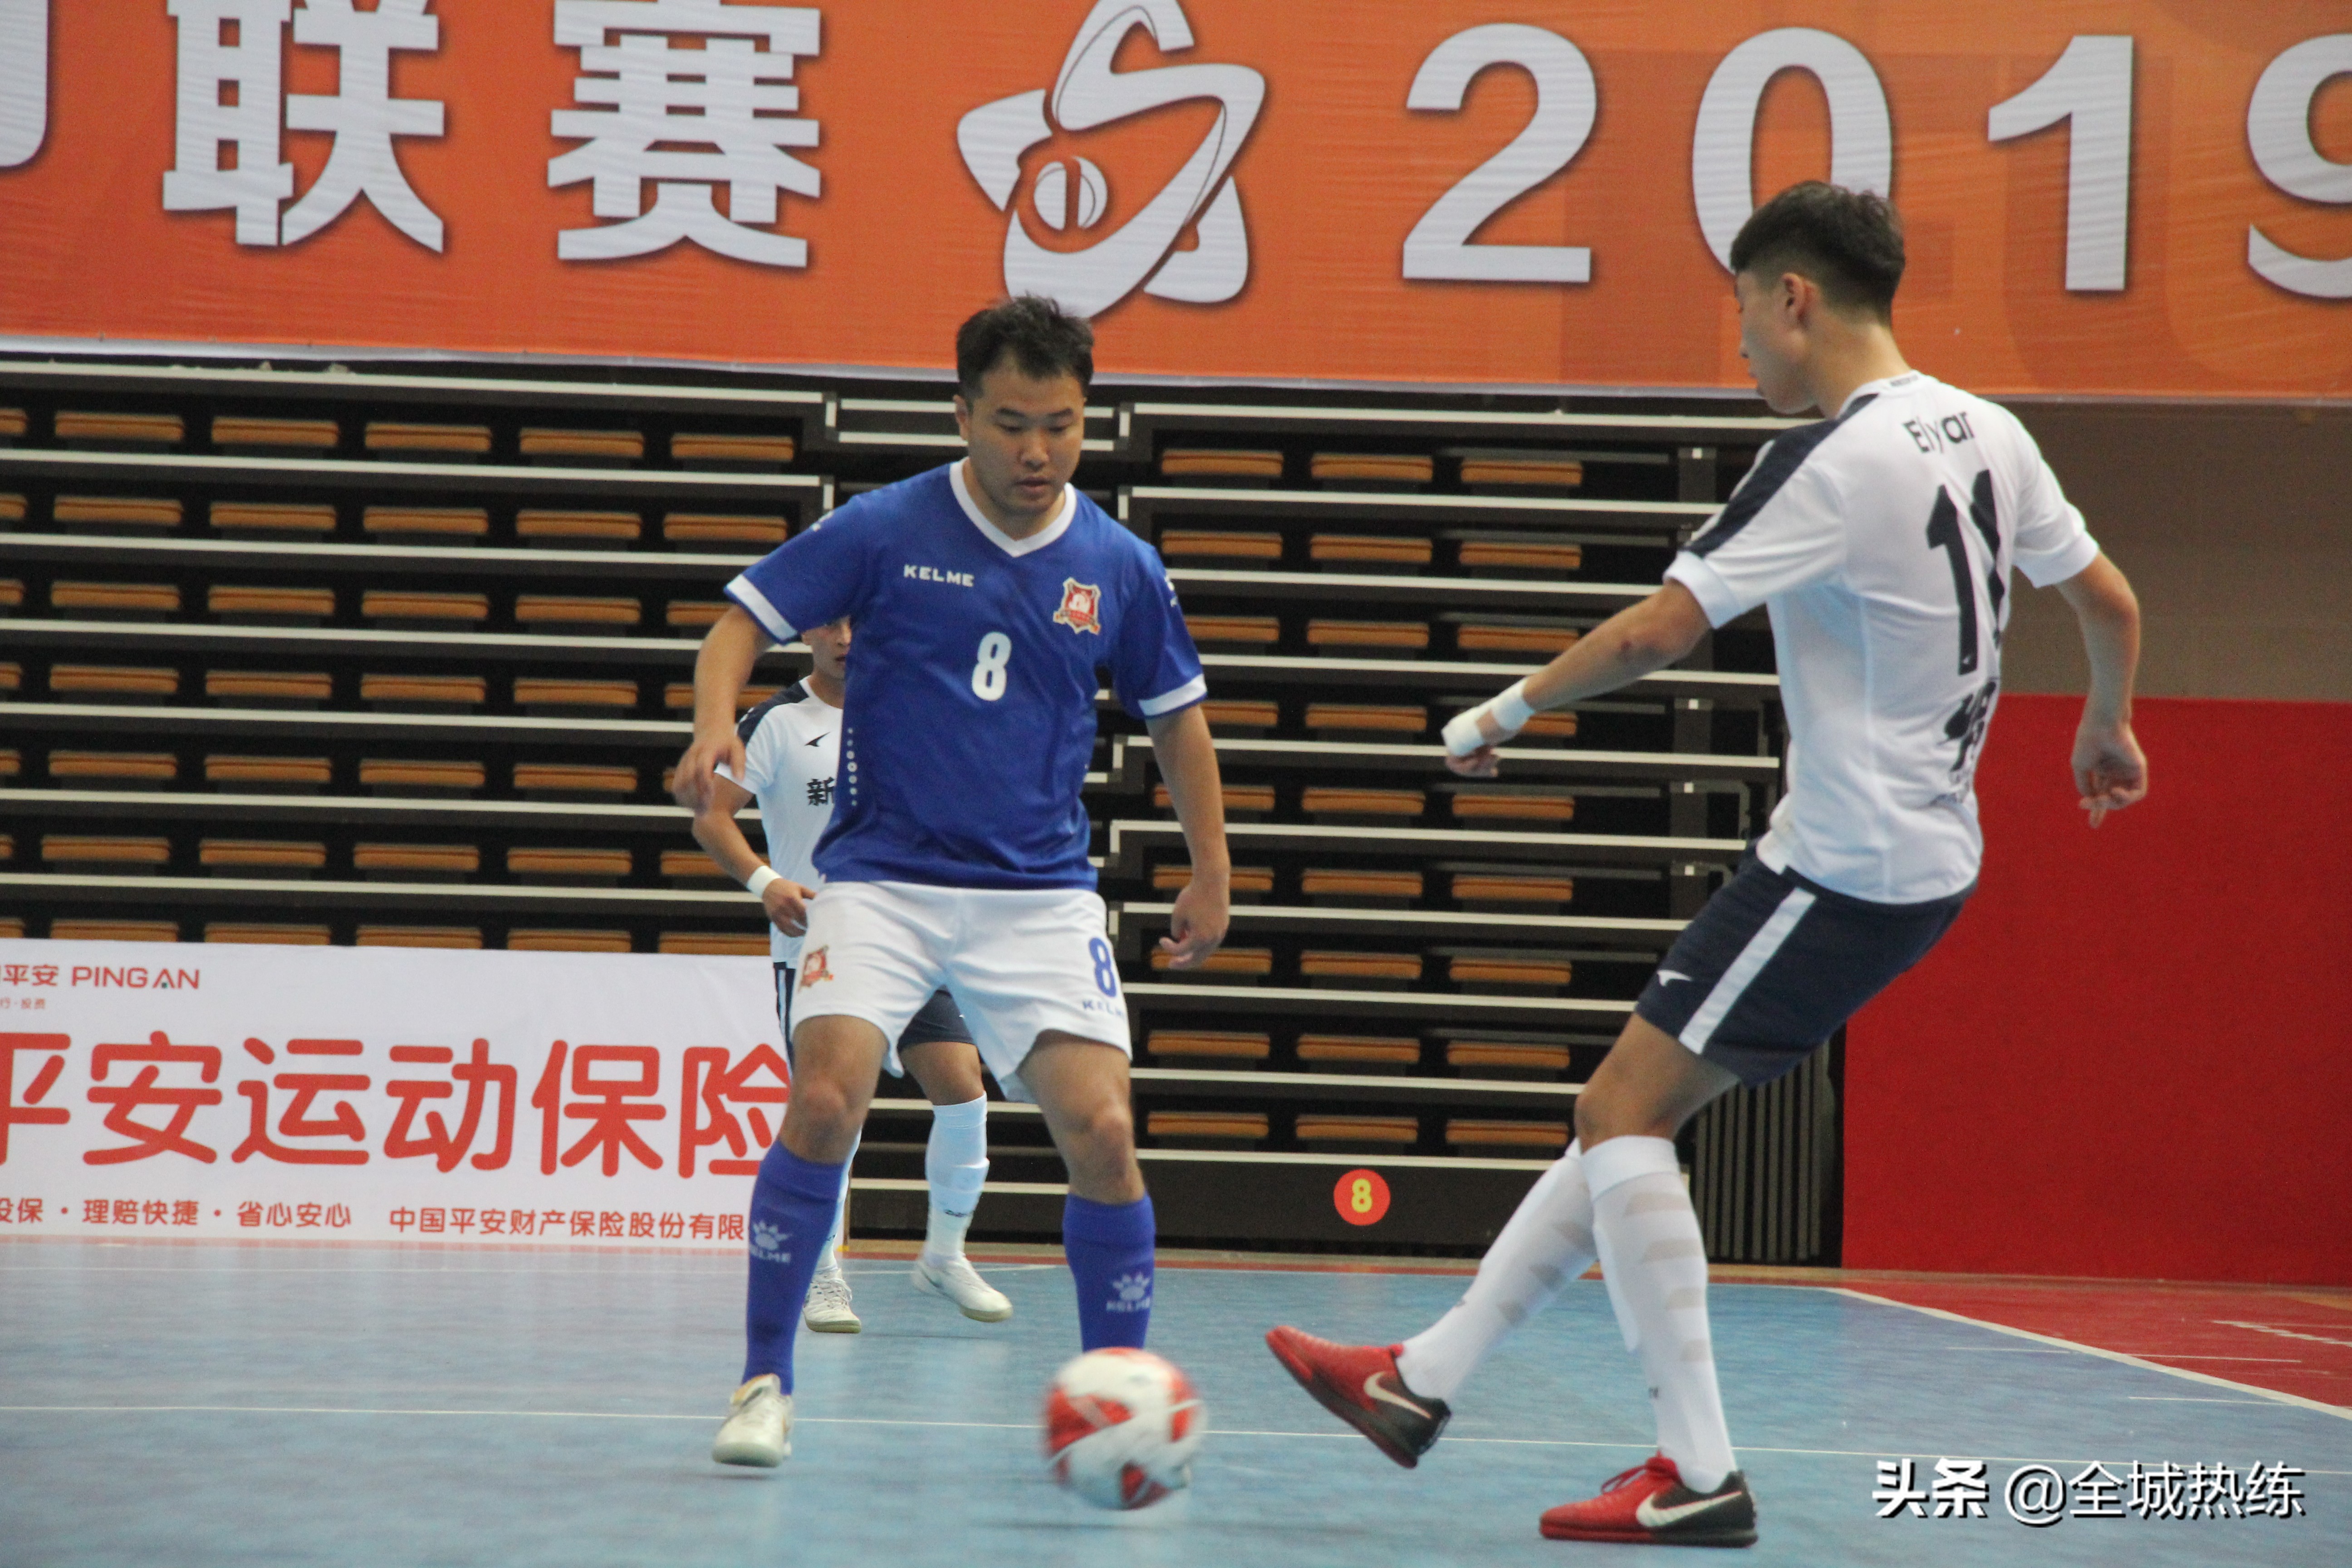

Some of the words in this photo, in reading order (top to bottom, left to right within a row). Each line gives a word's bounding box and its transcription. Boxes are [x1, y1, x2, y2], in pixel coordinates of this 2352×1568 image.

[0, 0, 820, 267] 联赛
[1403, 23, 2352, 298] 2019
[1903, 411, 1975, 454] Elyar
[903, 564, 975, 587] KELME
[971, 631, 1012, 701] 8
[0, 964, 59, 986] 平安
[1089, 937, 1117, 997] 8
[1351, 1178, 1373, 1213] 8
